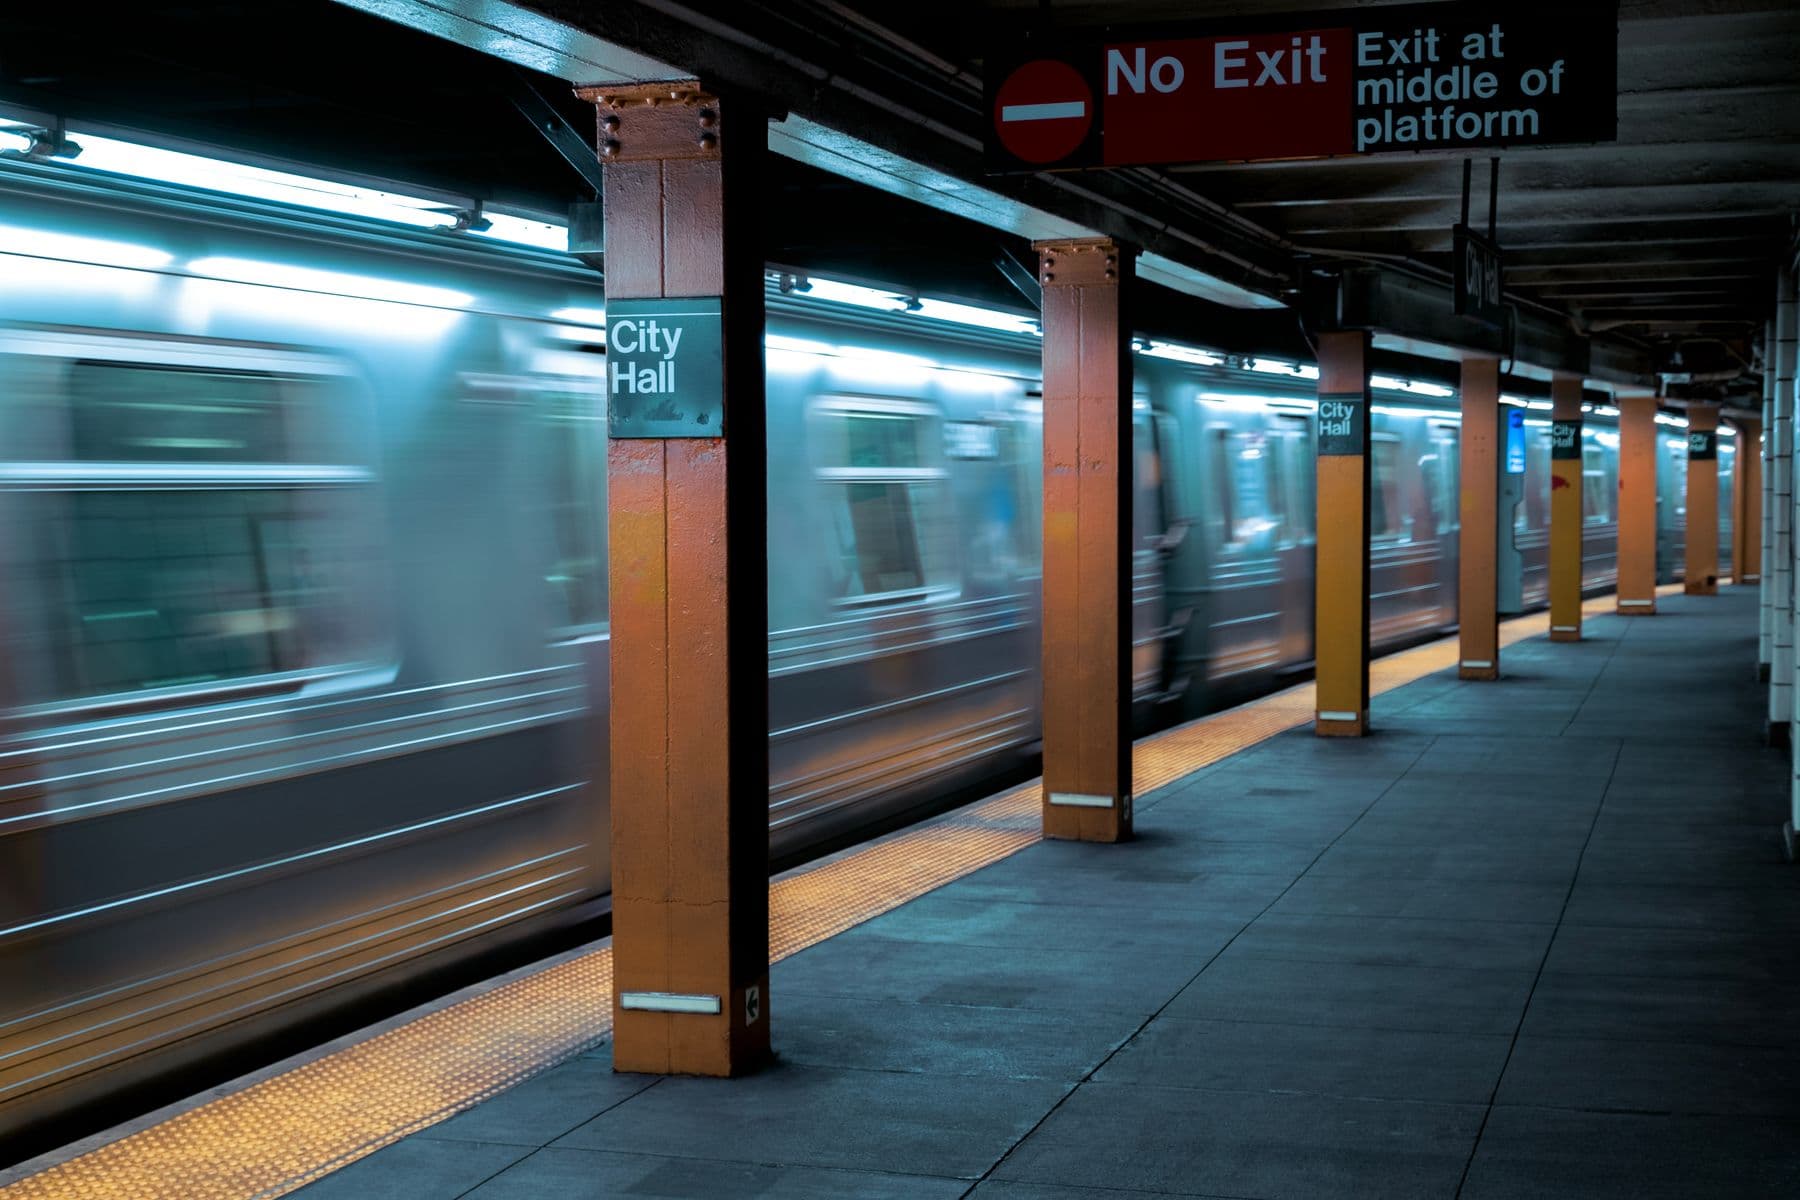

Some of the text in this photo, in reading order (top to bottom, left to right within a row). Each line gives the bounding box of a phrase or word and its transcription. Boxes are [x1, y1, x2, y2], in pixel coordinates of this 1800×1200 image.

[1107, 36, 1327, 95] No Exit
[1357, 24, 1504, 67] Exit at
[1357, 59, 1564, 105] middle of
[1357, 105, 1539, 152] platform
[1466, 239, 1482, 310] City
[611, 320, 683, 360] City
[611, 361, 675, 394] Hall
[1320, 402, 1354, 420] City
[1320, 420, 1351, 436] Hall
[1553, 424, 1576, 438] City
